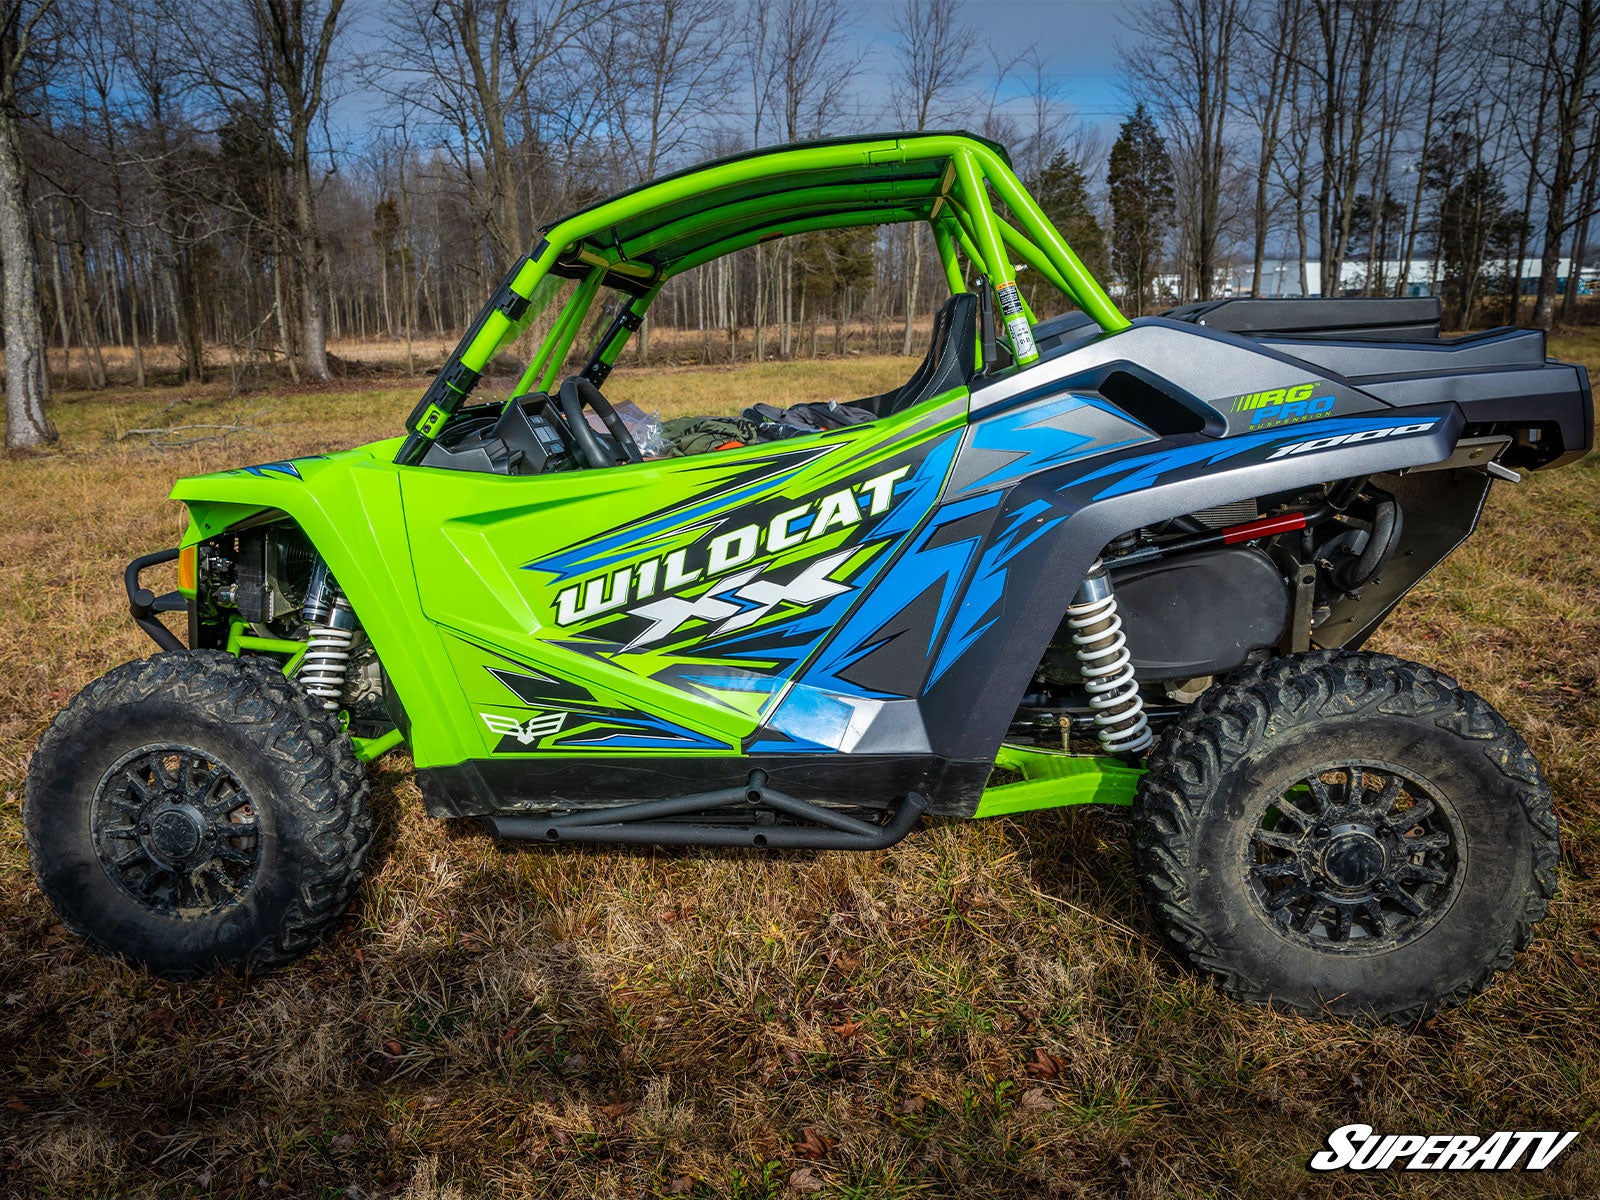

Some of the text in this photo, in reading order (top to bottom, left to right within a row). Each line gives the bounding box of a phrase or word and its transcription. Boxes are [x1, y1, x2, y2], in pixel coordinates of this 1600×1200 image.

[1248, 411, 1331, 431] SUSPENSION
[1250, 396, 1336, 425] PRO
[1265, 422, 1435, 461] 1000
[555, 464, 911, 627] WILDCAT
[618, 544, 865, 655] XX
